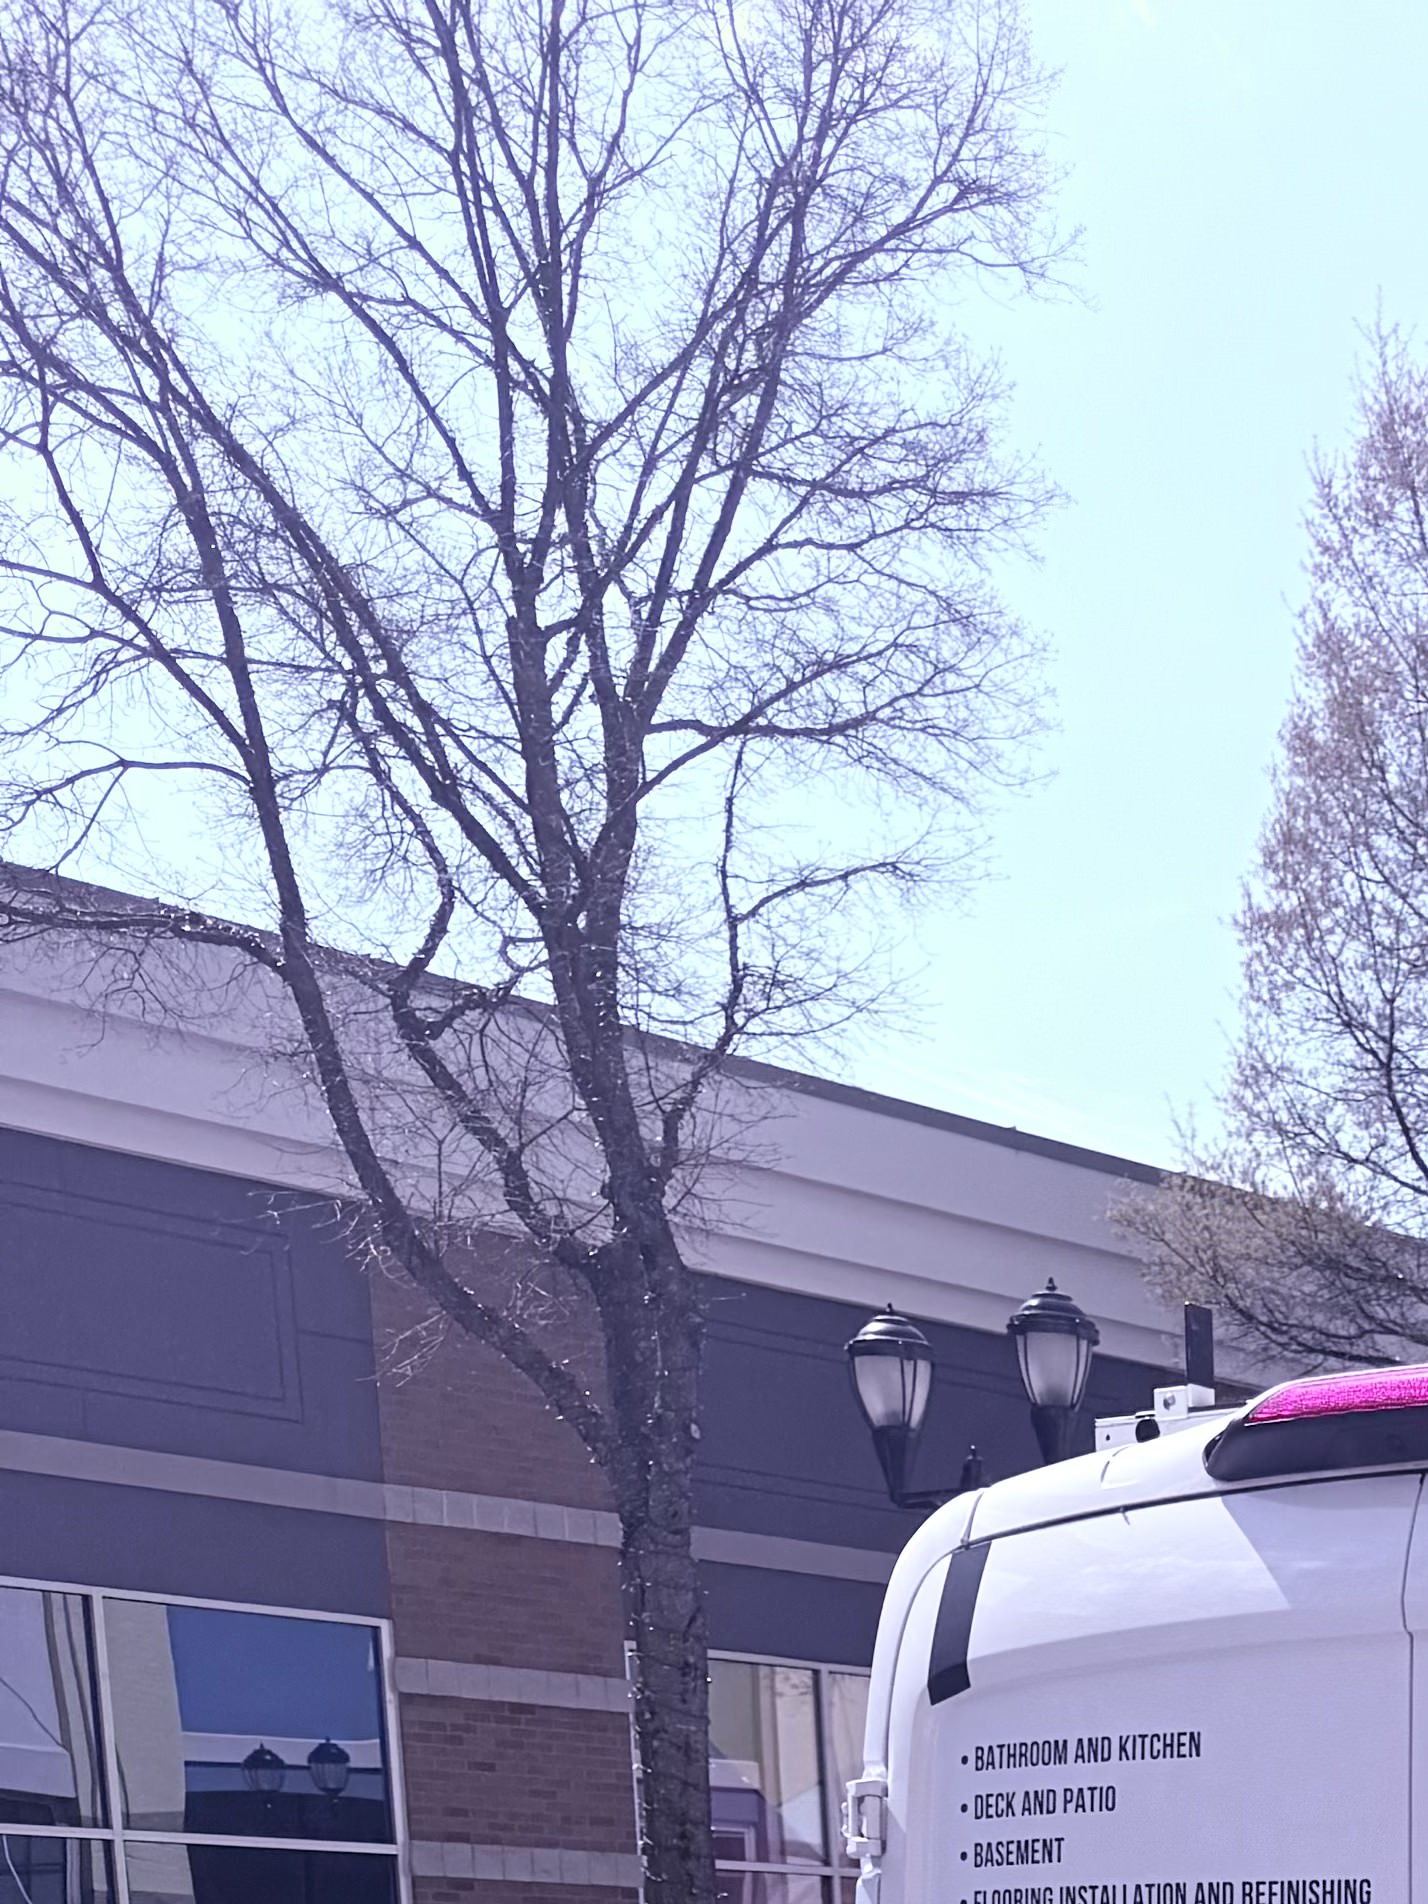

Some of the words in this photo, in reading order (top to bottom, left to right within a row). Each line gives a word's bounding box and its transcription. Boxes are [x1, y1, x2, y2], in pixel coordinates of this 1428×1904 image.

[974, 1738, 1067, 1771] BATHROOM
[1073, 1736, 1111, 1763] AND
[1118, 1731, 1201, 1761] KITCHEN
[973, 1791, 1015, 1819] DECK
[1021, 1788, 1056, 1816] AND
[1063, 1785, 1116, 1813] PATIO
[973, 1837, 1064, 1868] BASEMENT
